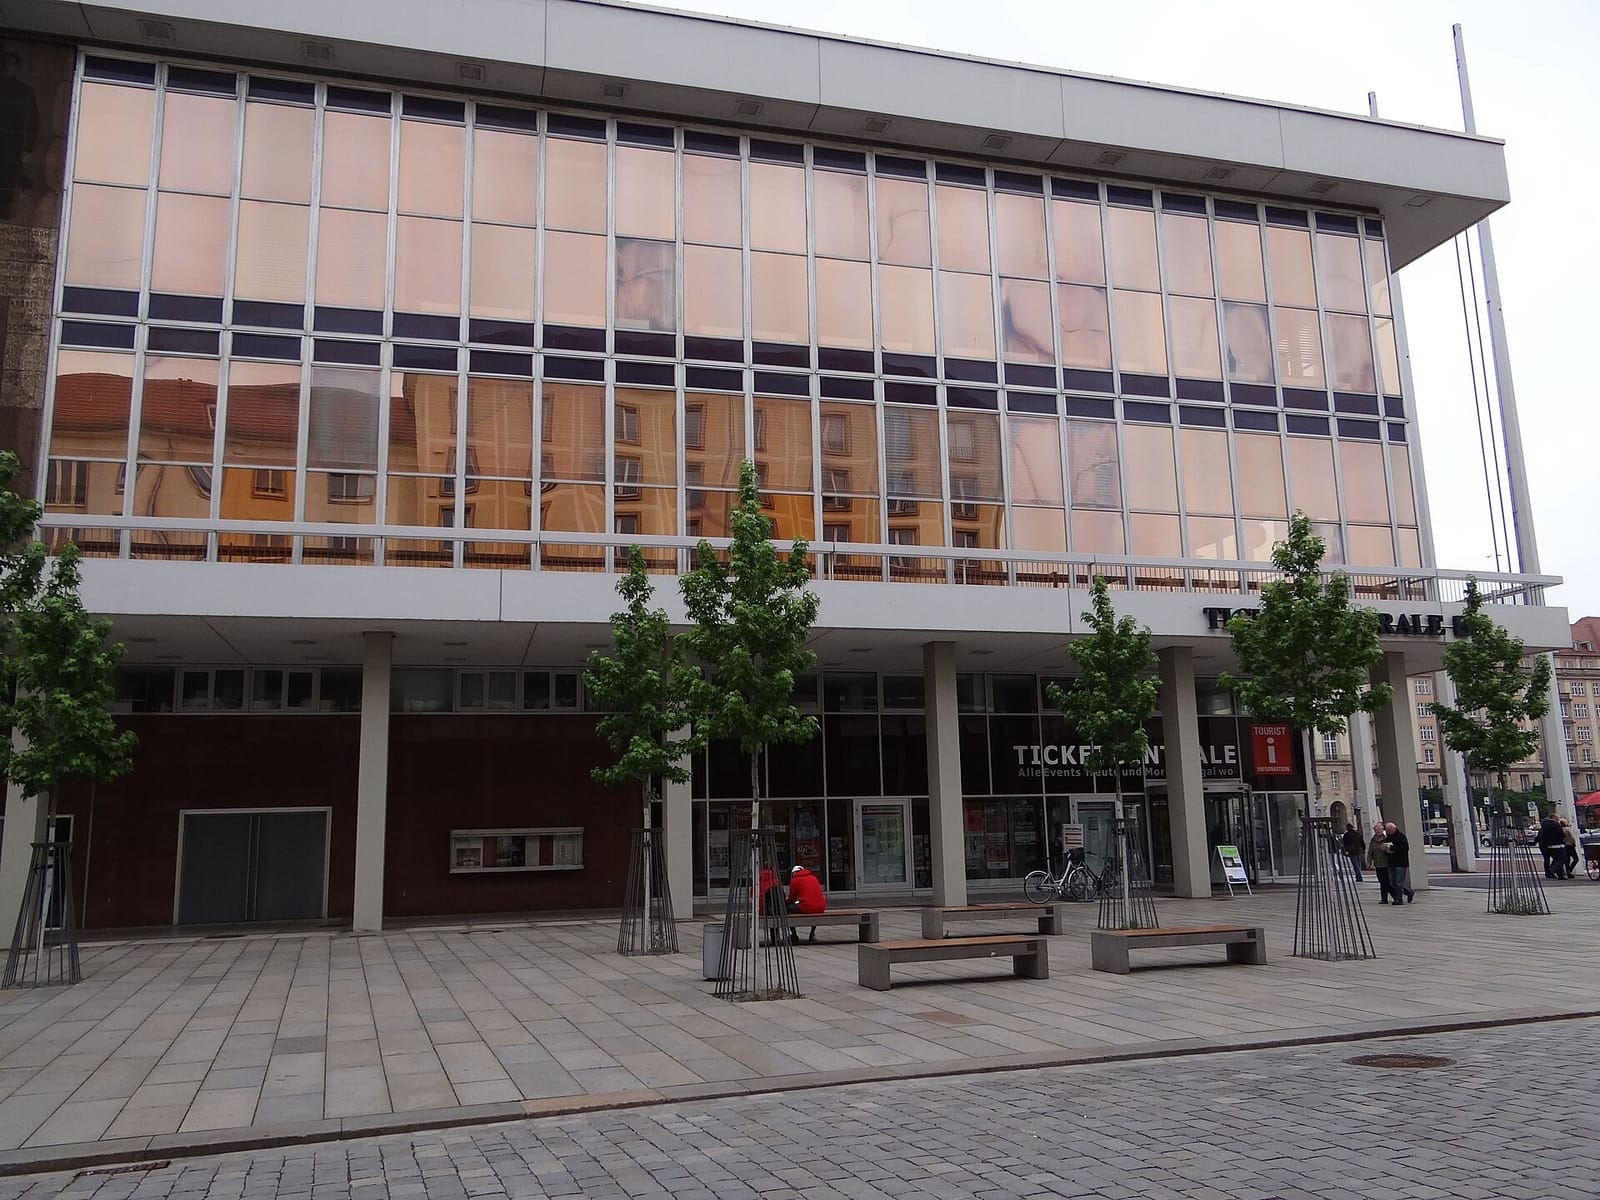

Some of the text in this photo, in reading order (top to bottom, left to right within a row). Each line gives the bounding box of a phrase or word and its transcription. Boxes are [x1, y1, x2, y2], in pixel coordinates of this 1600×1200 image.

[1252, 727, 1286, 736] TOURIST
[1018, 767, 1042, 777] Alle
[1044, 767, 1081, 777] Events
[1122, 766, 1142, 777] und
[1218, 768, 1234, 776] wo
